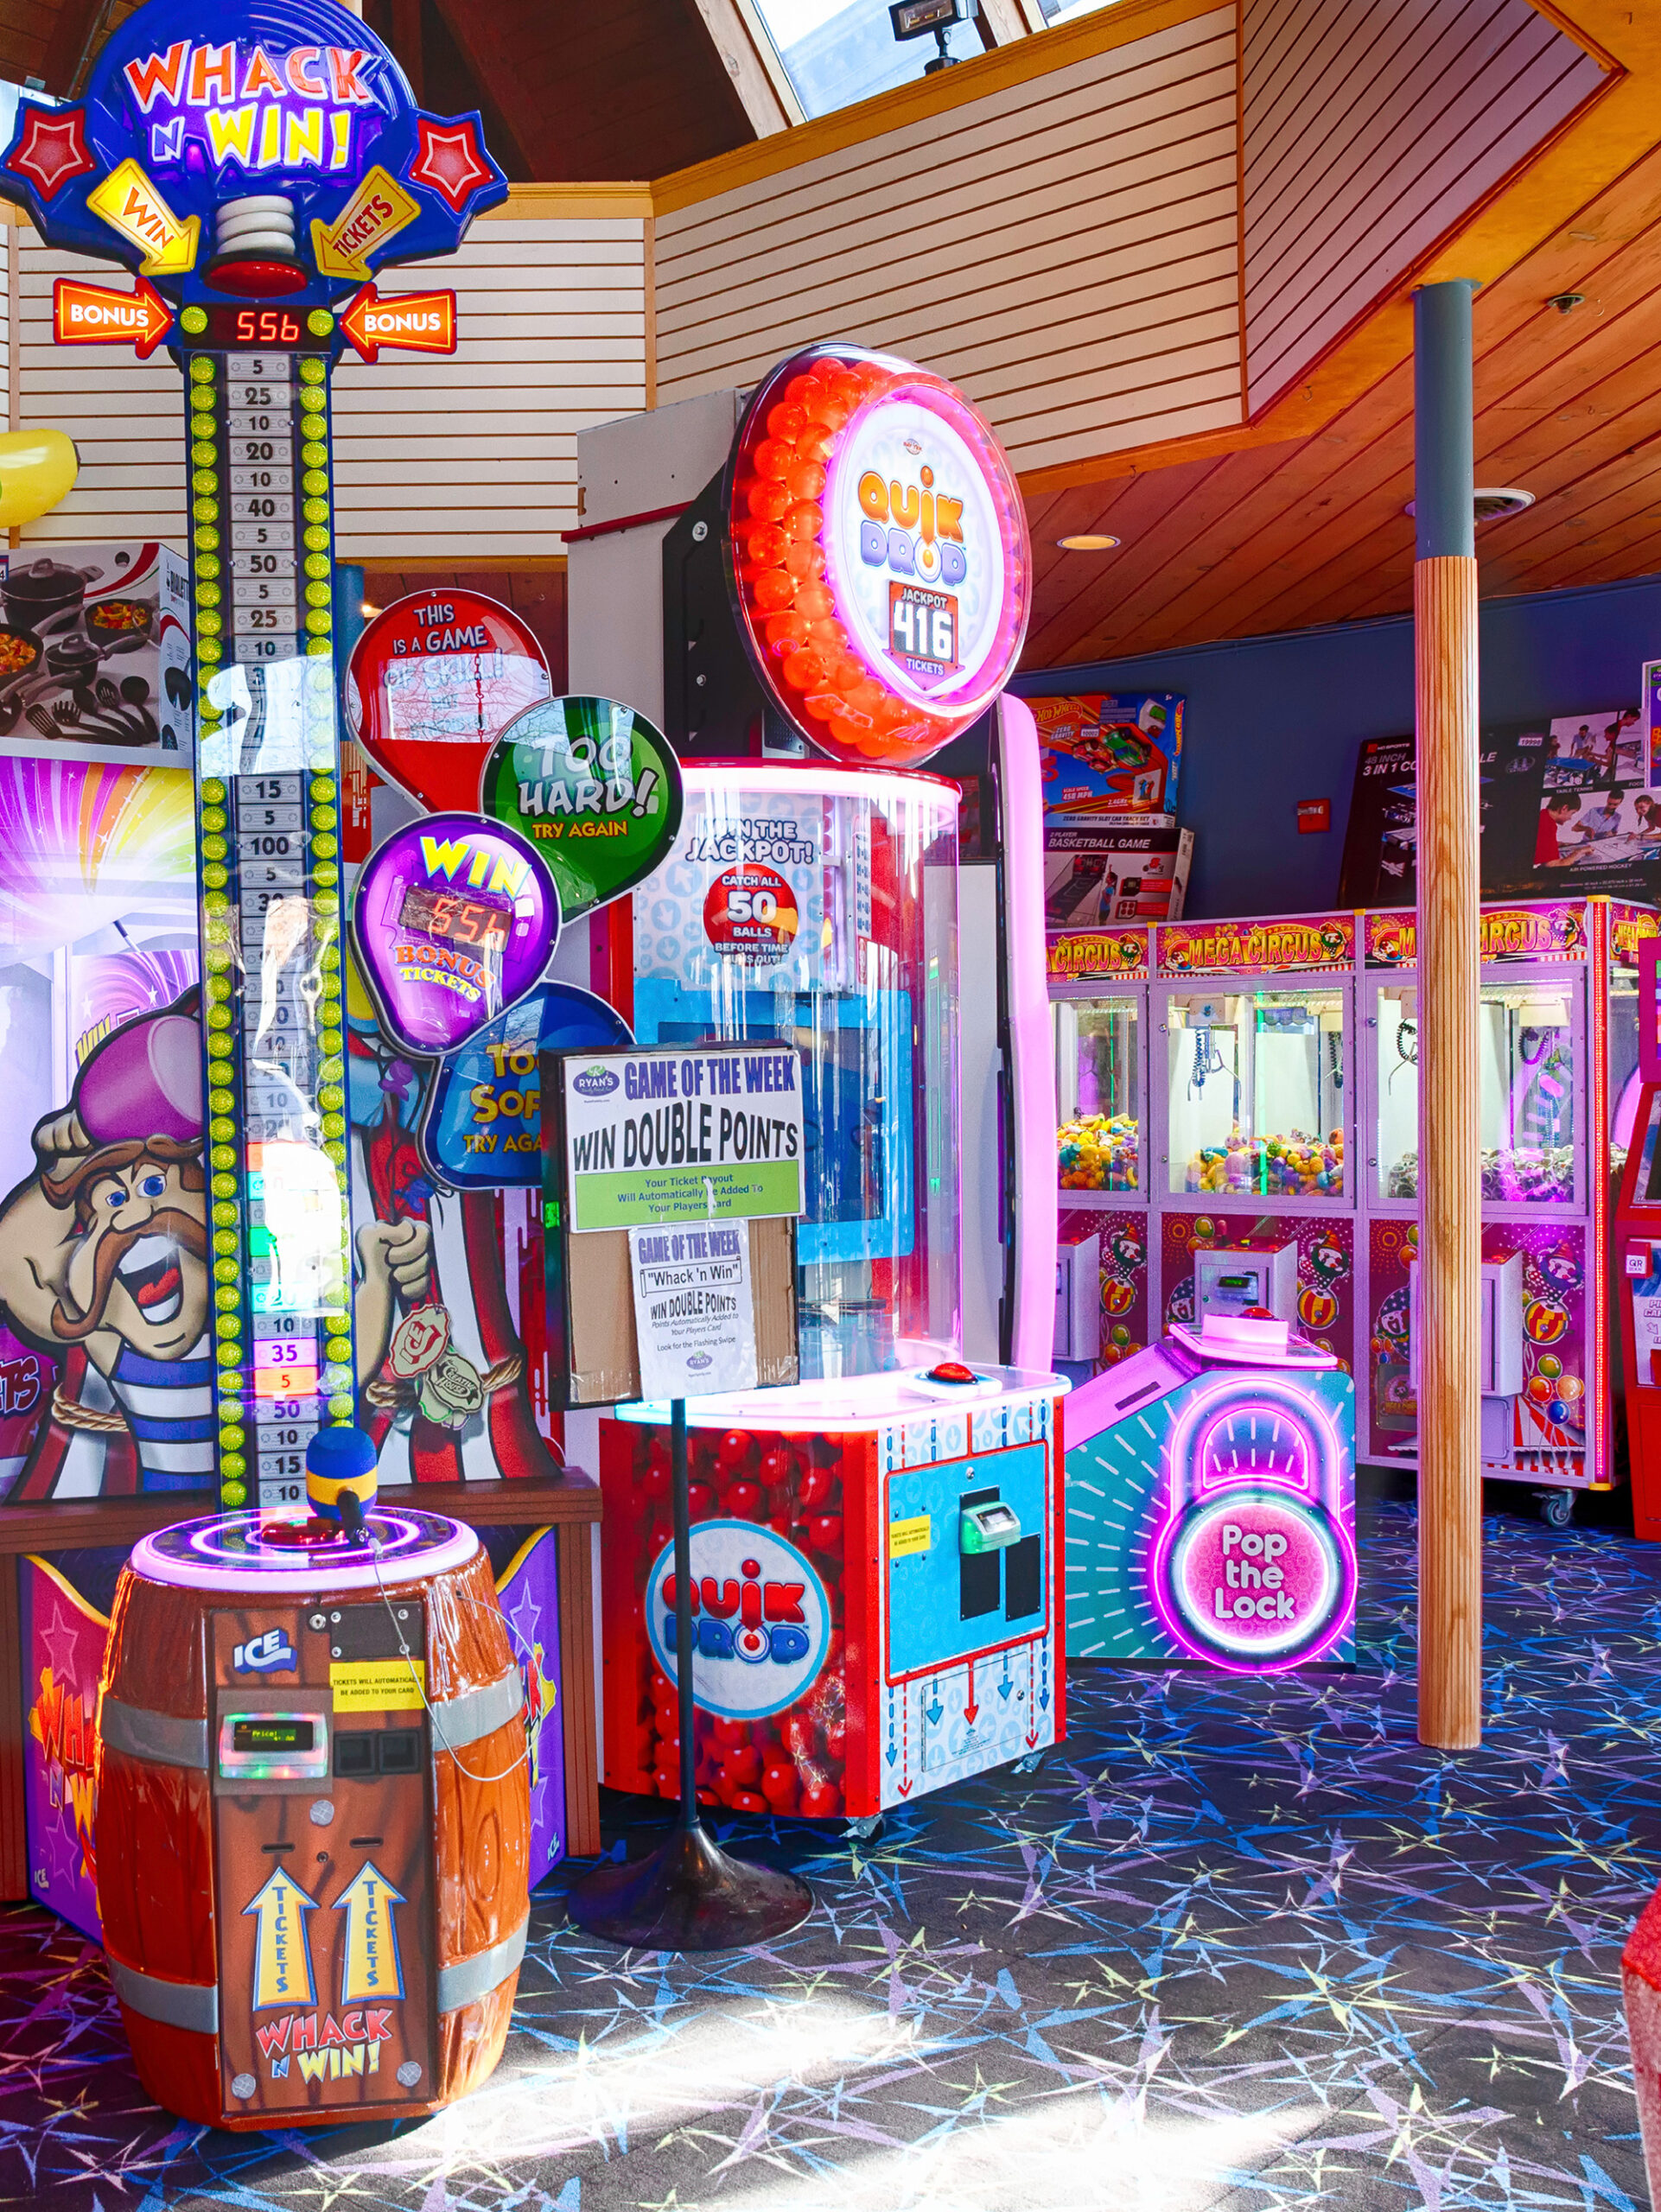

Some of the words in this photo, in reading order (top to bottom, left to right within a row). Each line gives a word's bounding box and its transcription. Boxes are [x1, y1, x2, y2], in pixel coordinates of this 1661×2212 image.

[124, 40, 373, 113] WHACK
[151, 116, 184, 162] N
[206, 103, 351, 169] WIN!
[122, 185, 175, 251] WIN
[332, 193, 395, 259] TICKETS
[69, 303, 150, 328] BONUS
[364, 311, 442, 334] BONUS
[252, 359, 264, 374] 5
[245, 387, 272, 406] 25
[249, 416, 270, 430] 10
[245, 442, 274, 461] 20
[250, 472, 271, 487] 10
[247, 499, 276, 518] 40
[858, 465, 964, 546] QUIK
[257, 529, 268, 543] 5
[860, 518, 967, 587] DROP
[250, 555, 277, 573] 50
[258, 585, 269, 600] 5
[901, 588, 948, 609] JACKPOT
[250, 609, 278, 628] 25
[413, 603, 455, 627] THIS
[894, 600, 952, 659] 416
[254, 641, 276, 657] 10
[392, 639, 406, 655] IS
[410, 638, 422, 653] A
[425, 625, 488, 653] GAME
[906, 658, 945, 677] TICKETS
[1036, 709, 1053, 722] HOT
[534, 734, 634, 778] TOO
[1378, 753, 1407, 764] INCH
[1363, 766, 1372, 776] 3
[1372, 763, 1389, 775] IN
[1391, 762, 1398, 772] 1
[254, 779, 283, 800] 15
[516, 767, 660, 818] HARD!
[264, 810, 276, 826] 5
[531, 823, 564, 839] TRY
[568, 820, 628, 837] AGAIN
[752, 819, 798, 841] THE
[250, 836, 290, 855] 100
[685, 837, 814, 864] JACKPOT!
[1048, 838, 1116, 849] BASKETBALL
[1117, 839, 1151, 849] GAME
[265, 867, 277, 881] 5
[419, 835, 533, 900] WIN
[722, 875, 759, 887] CATCH
[761, 874, 782, 887] ALL
[727, 890, 777, 924] 50
[733, 926, 772, 938] BALLS
[715, 942, 759, 953] BEFORE
[761, 942, 789, 954] TIME
[1054, 942, 1123, 971] CIRCUS
[1188, 938, 1243, 967] MEGA
[1246, 931, 1323, 963] CIRCUS
[394, 944, 497, 990] BONUS
[759, 953, 784, 965] OUT!
[400, 967, 482, 1003] TICKETS
[579, 1073, 614, 1088] RYAN'S
[624, 1061, 678, 1101] GAME
[681, 1059, 703, 1097] OF
[707, 1058, 741, 1096] THE
[743, 1055, 796, 1094] WEEK
[265, 1092, 288, 1109] 10
[463, 1134, 499, 1154] TRY
[502, 1134, 541, 1153] AGA
[573, 1124, 616, 1172] WIN
[624, 1100, 713, 1168] DOUBLE
[720, 1107, 799, 1162] POINTS
[645, 1179, 667, 1188] Your
[670, 1176, 698, 1186] Ticket
[617, 1193, 636, 1203] Will
[638, 1189, 703, 1202] Automatically
[720, 1185, 749, 1195] Added
[752, 1184, 763, 1193] To
[648, 1204, 671, 1213] Your
[673, 1200, 708, 1212] Players
[638, 1236, 670, 1265] GAME
[671, 1234, 685, 1262] OF
[686, 1231, 708, 1260] THE
[709, 1229, 741, 1257] WEEK
[1629, 1259, 1644, 1268] QR
[648, 1268, 694, 1287] "Whack
[710, 1263, 738, 1280] Win"
[651, 1300, 667, 1320] WIN
[669, 1290, 703, 1318] DOUBLE
[705, 1293, 737, 1314] POINTS
[272, 1317, 295, 1333] 10
[652, 1320, 670, 1329] Points
[671, 1315, 710, 1326] Automatically
[711, 1313, 731, 1322] Added
[671, 1327, 685, 1337] Your
[685, 1326, 706, 1336] Players
[707, 1322, 722, 1332] Card
[270, 1344, 298, 1363] 35
[657, 1343, 671, 1352] Look
[693, 1338, 718, 1348] Flashing
[718, 1336, 736, 1345] Swipe
[281, 1374, 291, 1389] 5
[273, 1400, 301, 1420] 50
[276, 1429, 298, 1446] 10
[274, 1457, 302, 1474] 15
[277, 1484, 300, 1501] 10
[1222, 1524, 1288, 1564] Pop
[1225, 1559, 1284, 1590] the
[662, 1559, 806, 1632] QUIK
[1214, 1587, 1295, 1619] Lock
[664, 1613, 811, 1665] DROP
[232, 1628, 298, 1675] ICE
[34, 1866, 49, 1889] ICE
[271, 1885, 290, 1993] TICKETS
[362, 1879, 379, 1987] TICKETS
[255, 2008, 393, 2059] WHACK
[270, 2053, 290, 2078] N
[296, 2040, 381, 2085] WIN!
